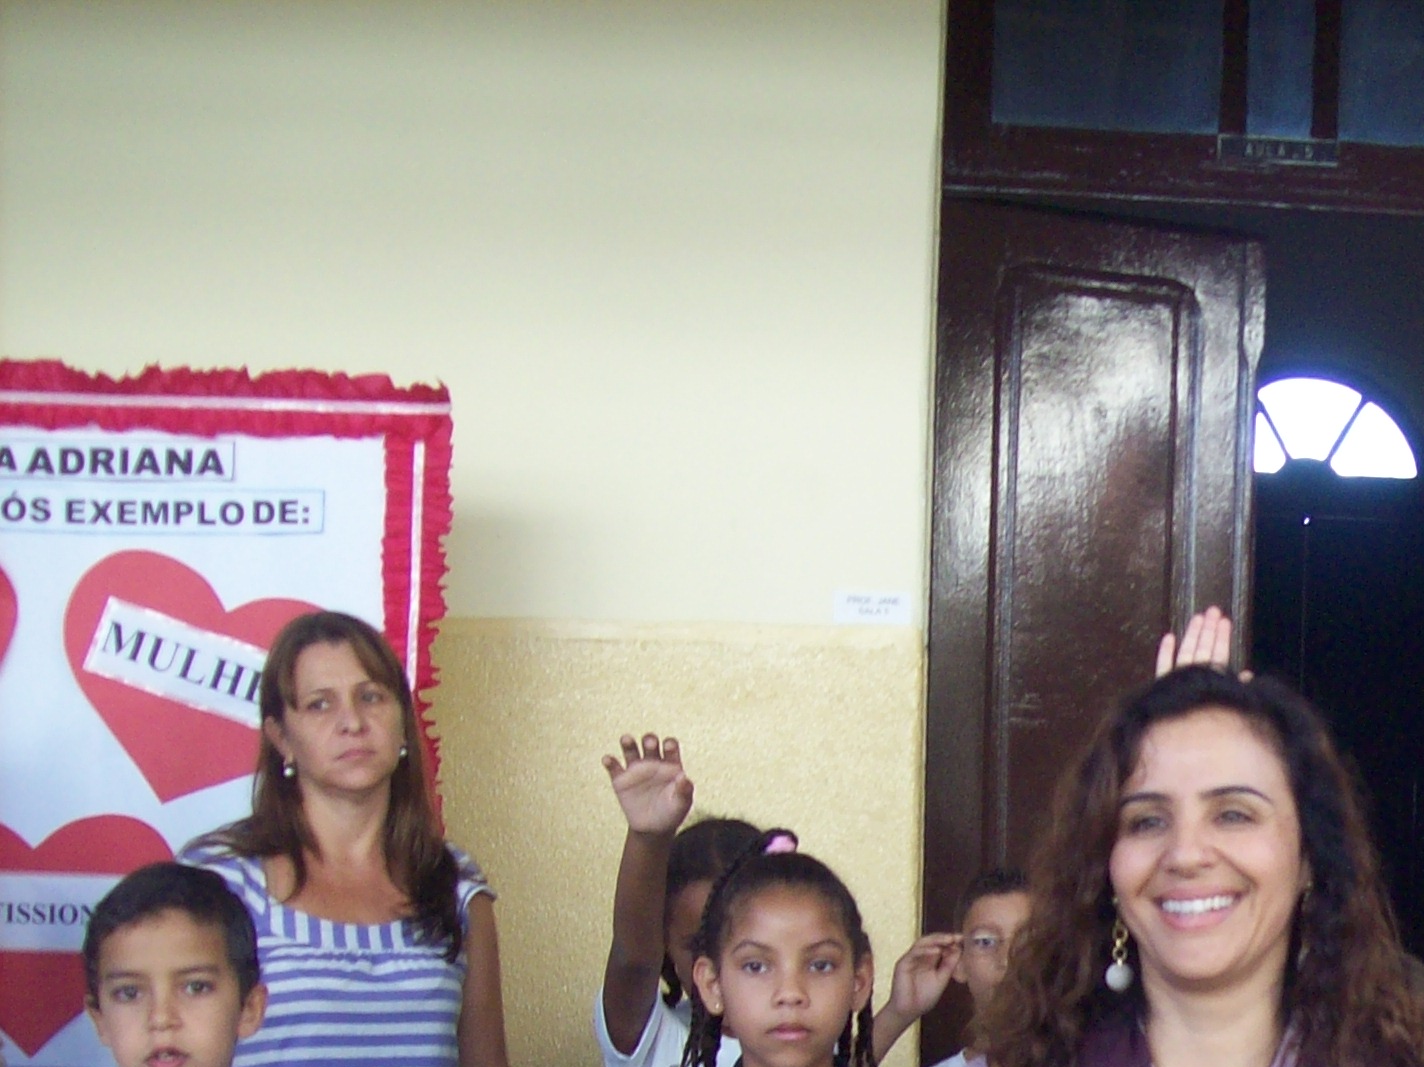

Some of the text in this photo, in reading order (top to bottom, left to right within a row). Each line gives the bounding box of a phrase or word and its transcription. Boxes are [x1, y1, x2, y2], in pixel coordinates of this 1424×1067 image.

[26, 447, 225, 476] ADRIANA
[65, 499, 245, 526] EXEMPLO
[253, 500, 310, 525] DE:
